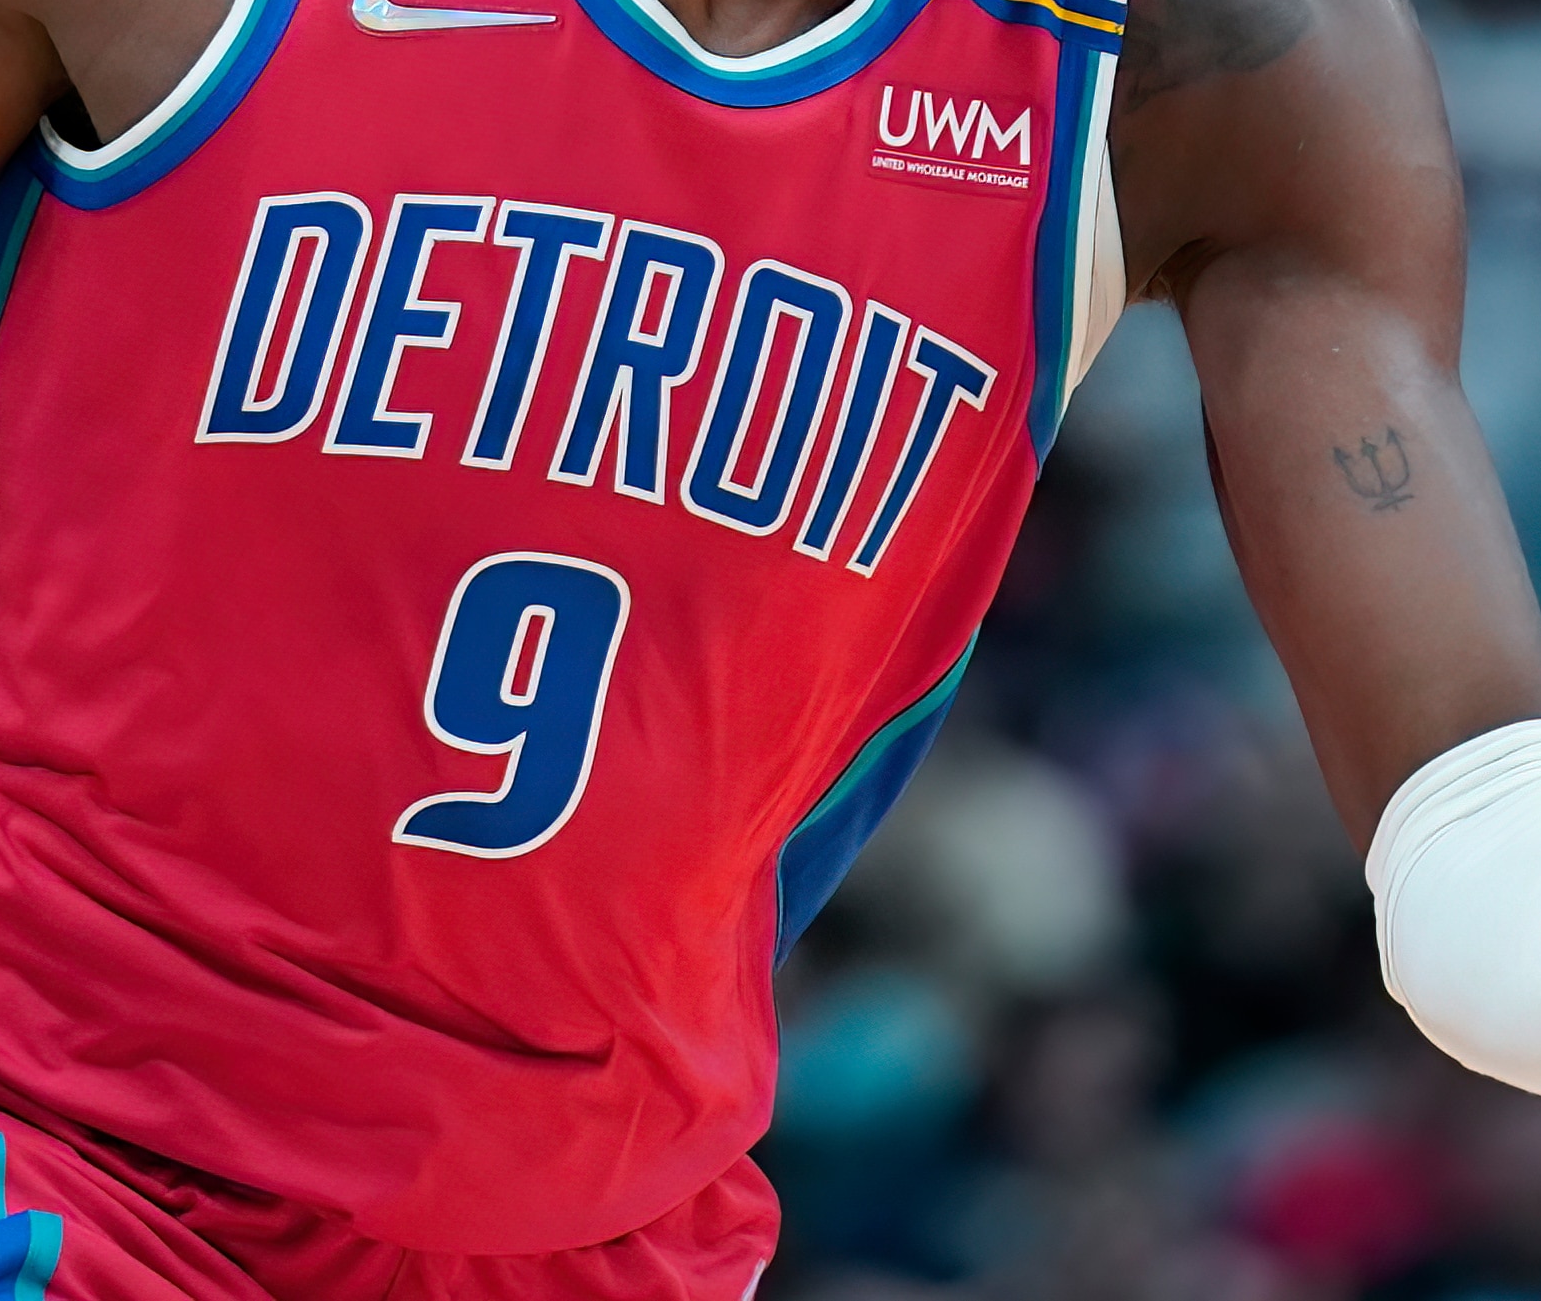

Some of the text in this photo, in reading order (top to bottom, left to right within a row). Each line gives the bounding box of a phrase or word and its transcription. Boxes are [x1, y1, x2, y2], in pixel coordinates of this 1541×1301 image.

[872, 156, 1029, 189] UNITED WHOLESALE MORTGAGE
[879, 85, 1031, 166] UWM
[194, 190, 999, 579] DETROIT
[391, 551, 632, 860] 9
